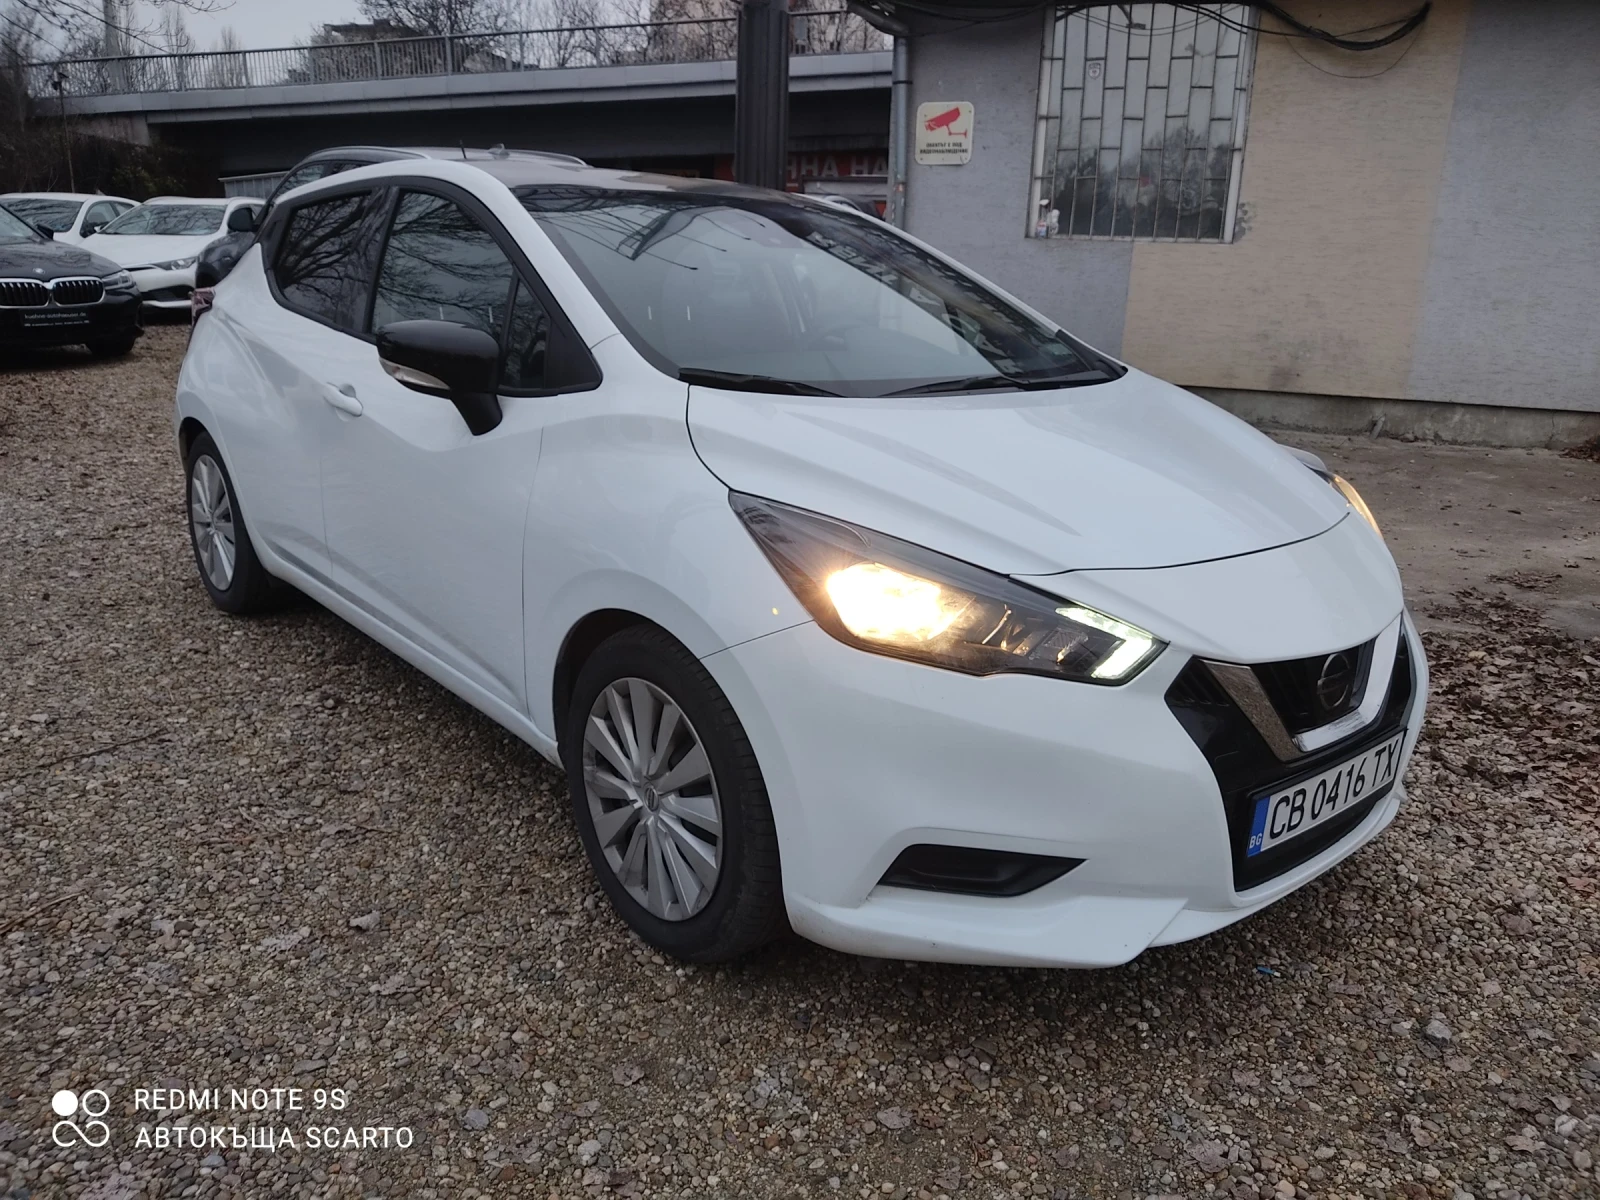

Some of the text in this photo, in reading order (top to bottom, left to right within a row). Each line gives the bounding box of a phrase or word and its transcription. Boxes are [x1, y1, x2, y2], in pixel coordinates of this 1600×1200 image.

[1269, 738, 1399, 840] CB 0416 TX
[1249, 833, 1263, 849] BG
